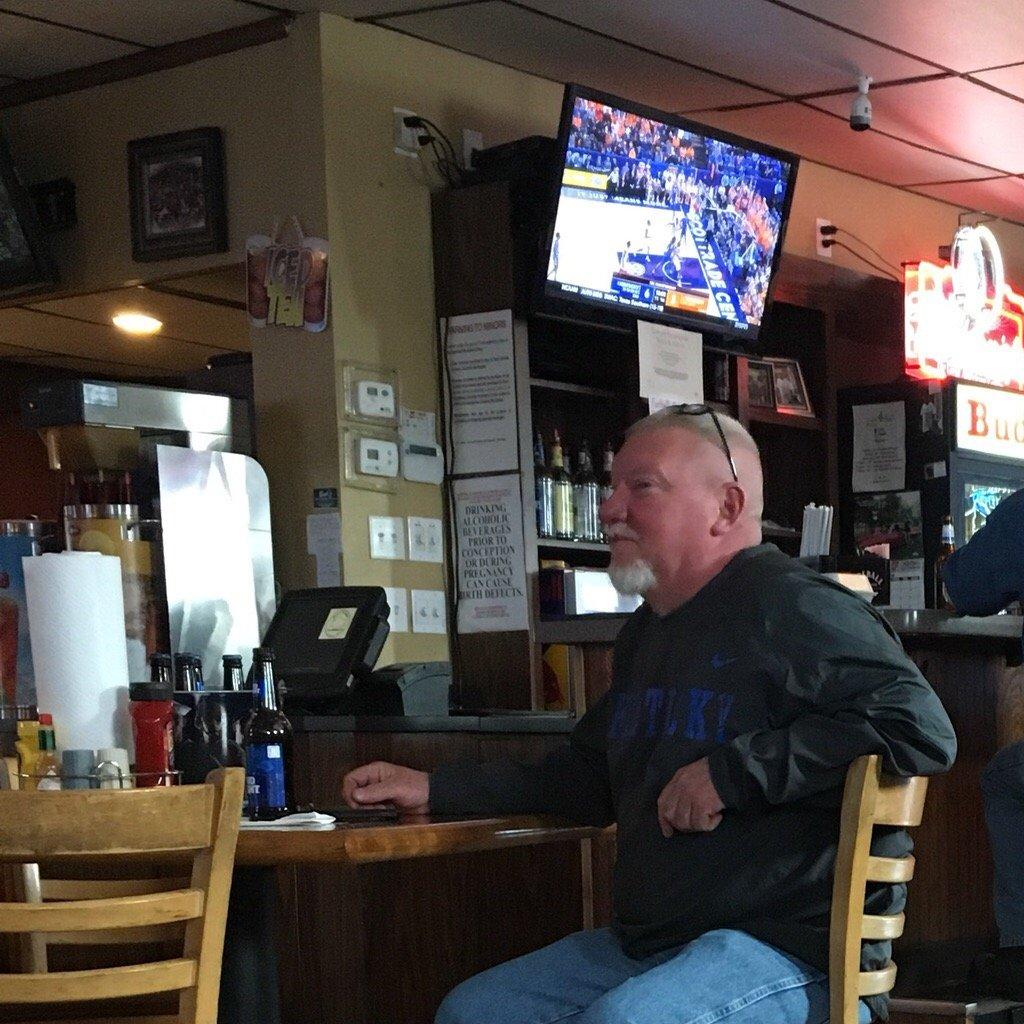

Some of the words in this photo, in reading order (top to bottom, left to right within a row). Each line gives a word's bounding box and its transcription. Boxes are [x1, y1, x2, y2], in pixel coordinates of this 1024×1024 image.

[465, 504, 507, 515] DRINKING
[463, 514, 509, 526] ALCOHOLIC
[463, 525, 511, 537] BEVERAGES
[468, 536, 494, 546] PRIOR
[496, 535, 507, 545] TO
[462, 545, 515, 557] CONCEPTION
[465, 559, 478, 568] OR
[480, 557, 512, 567] DURING
[464, 567, 514, 578] PREGNANCY
[466, 579, 484, 589] CAN
[485, 577, 511, 588] CAUSE
